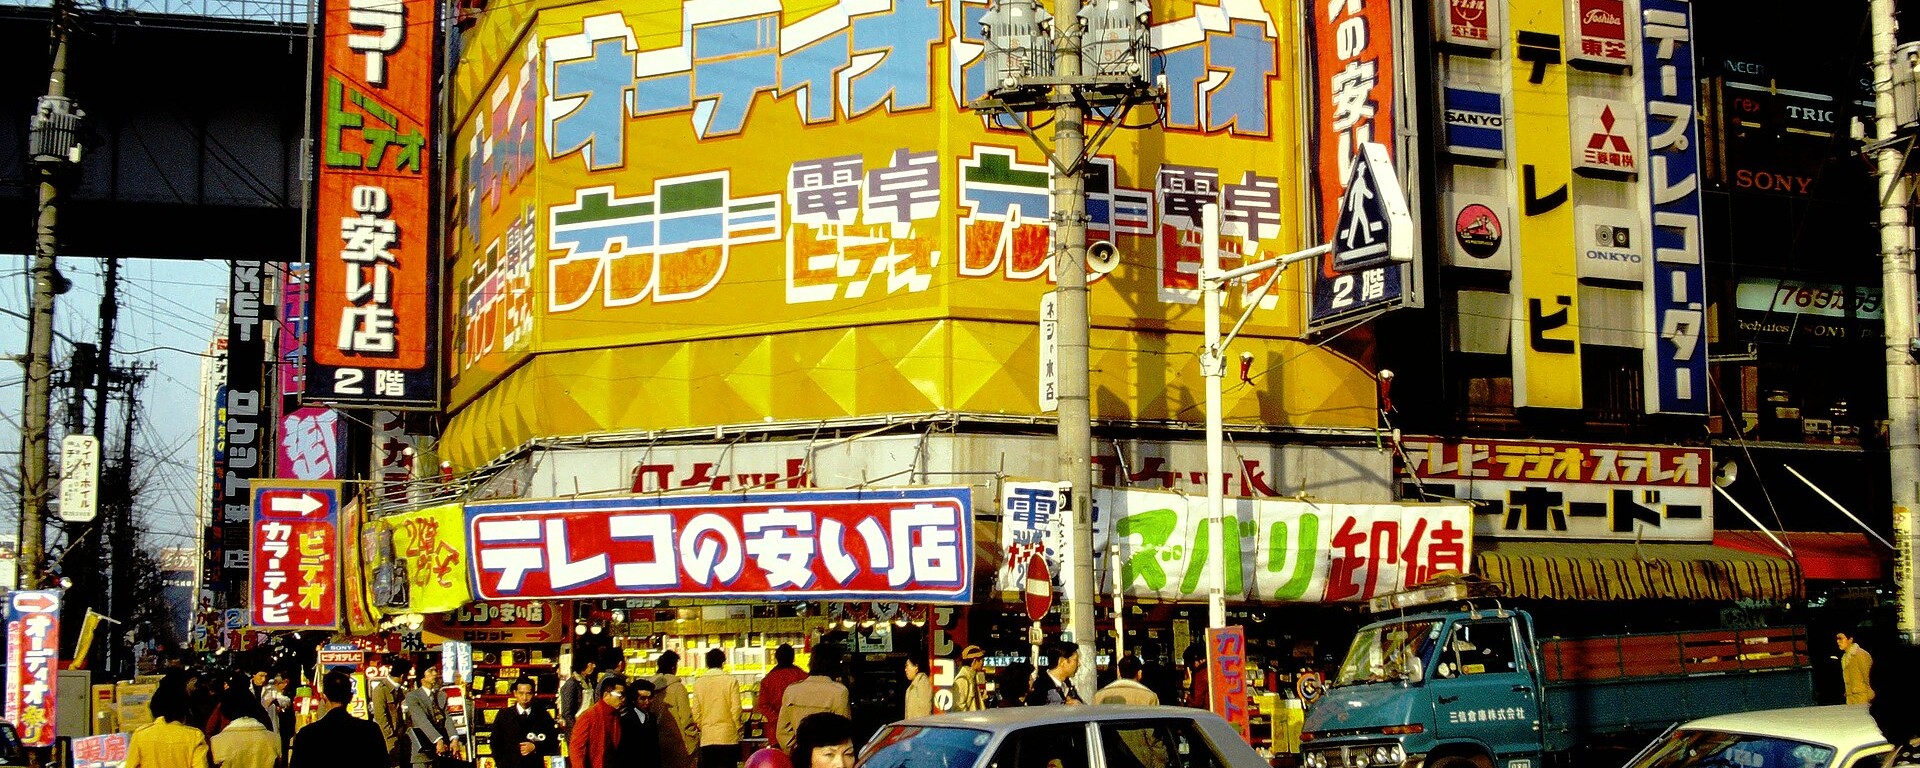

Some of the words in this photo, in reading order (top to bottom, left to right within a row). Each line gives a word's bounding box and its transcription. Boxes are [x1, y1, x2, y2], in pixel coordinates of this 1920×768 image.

[1582, 40, 1626, 59] 東芝
[1583, 9, 1622, 25] Toshiba
[326, 75, 425, 171] ビデオ
[543, 0, 945, 172] オーディオ
[1444, 111, 1502, 126] SANYO
[787, 148, 942, 235] 電卓
[1516, 29, 1576, 354] テレビ
[1584, 150, 1634, 168] 三菱電機
[1736, 169, 1812, 195] SONY
[337, 185, 397, 353] の安い店
[548, 170, 782, 314] カラー
[786, 222, 942, 304] ビデオ
[1586, 250, 1641, 263] ONKYO
[234, 260, 260, 341] KET
[1331, 268, 1385, 308] 2階
[333, 367, 405, 397] 2階
[478, 505, 959, 592] テレコの安い店
[1401, 484, 1705, 533] ーホードー
[262, 522, 294, 623] カラーテレビ
[298, 530, 330, 610] ビデオ
[321, 653, 362, 662] ビデオテレビ
